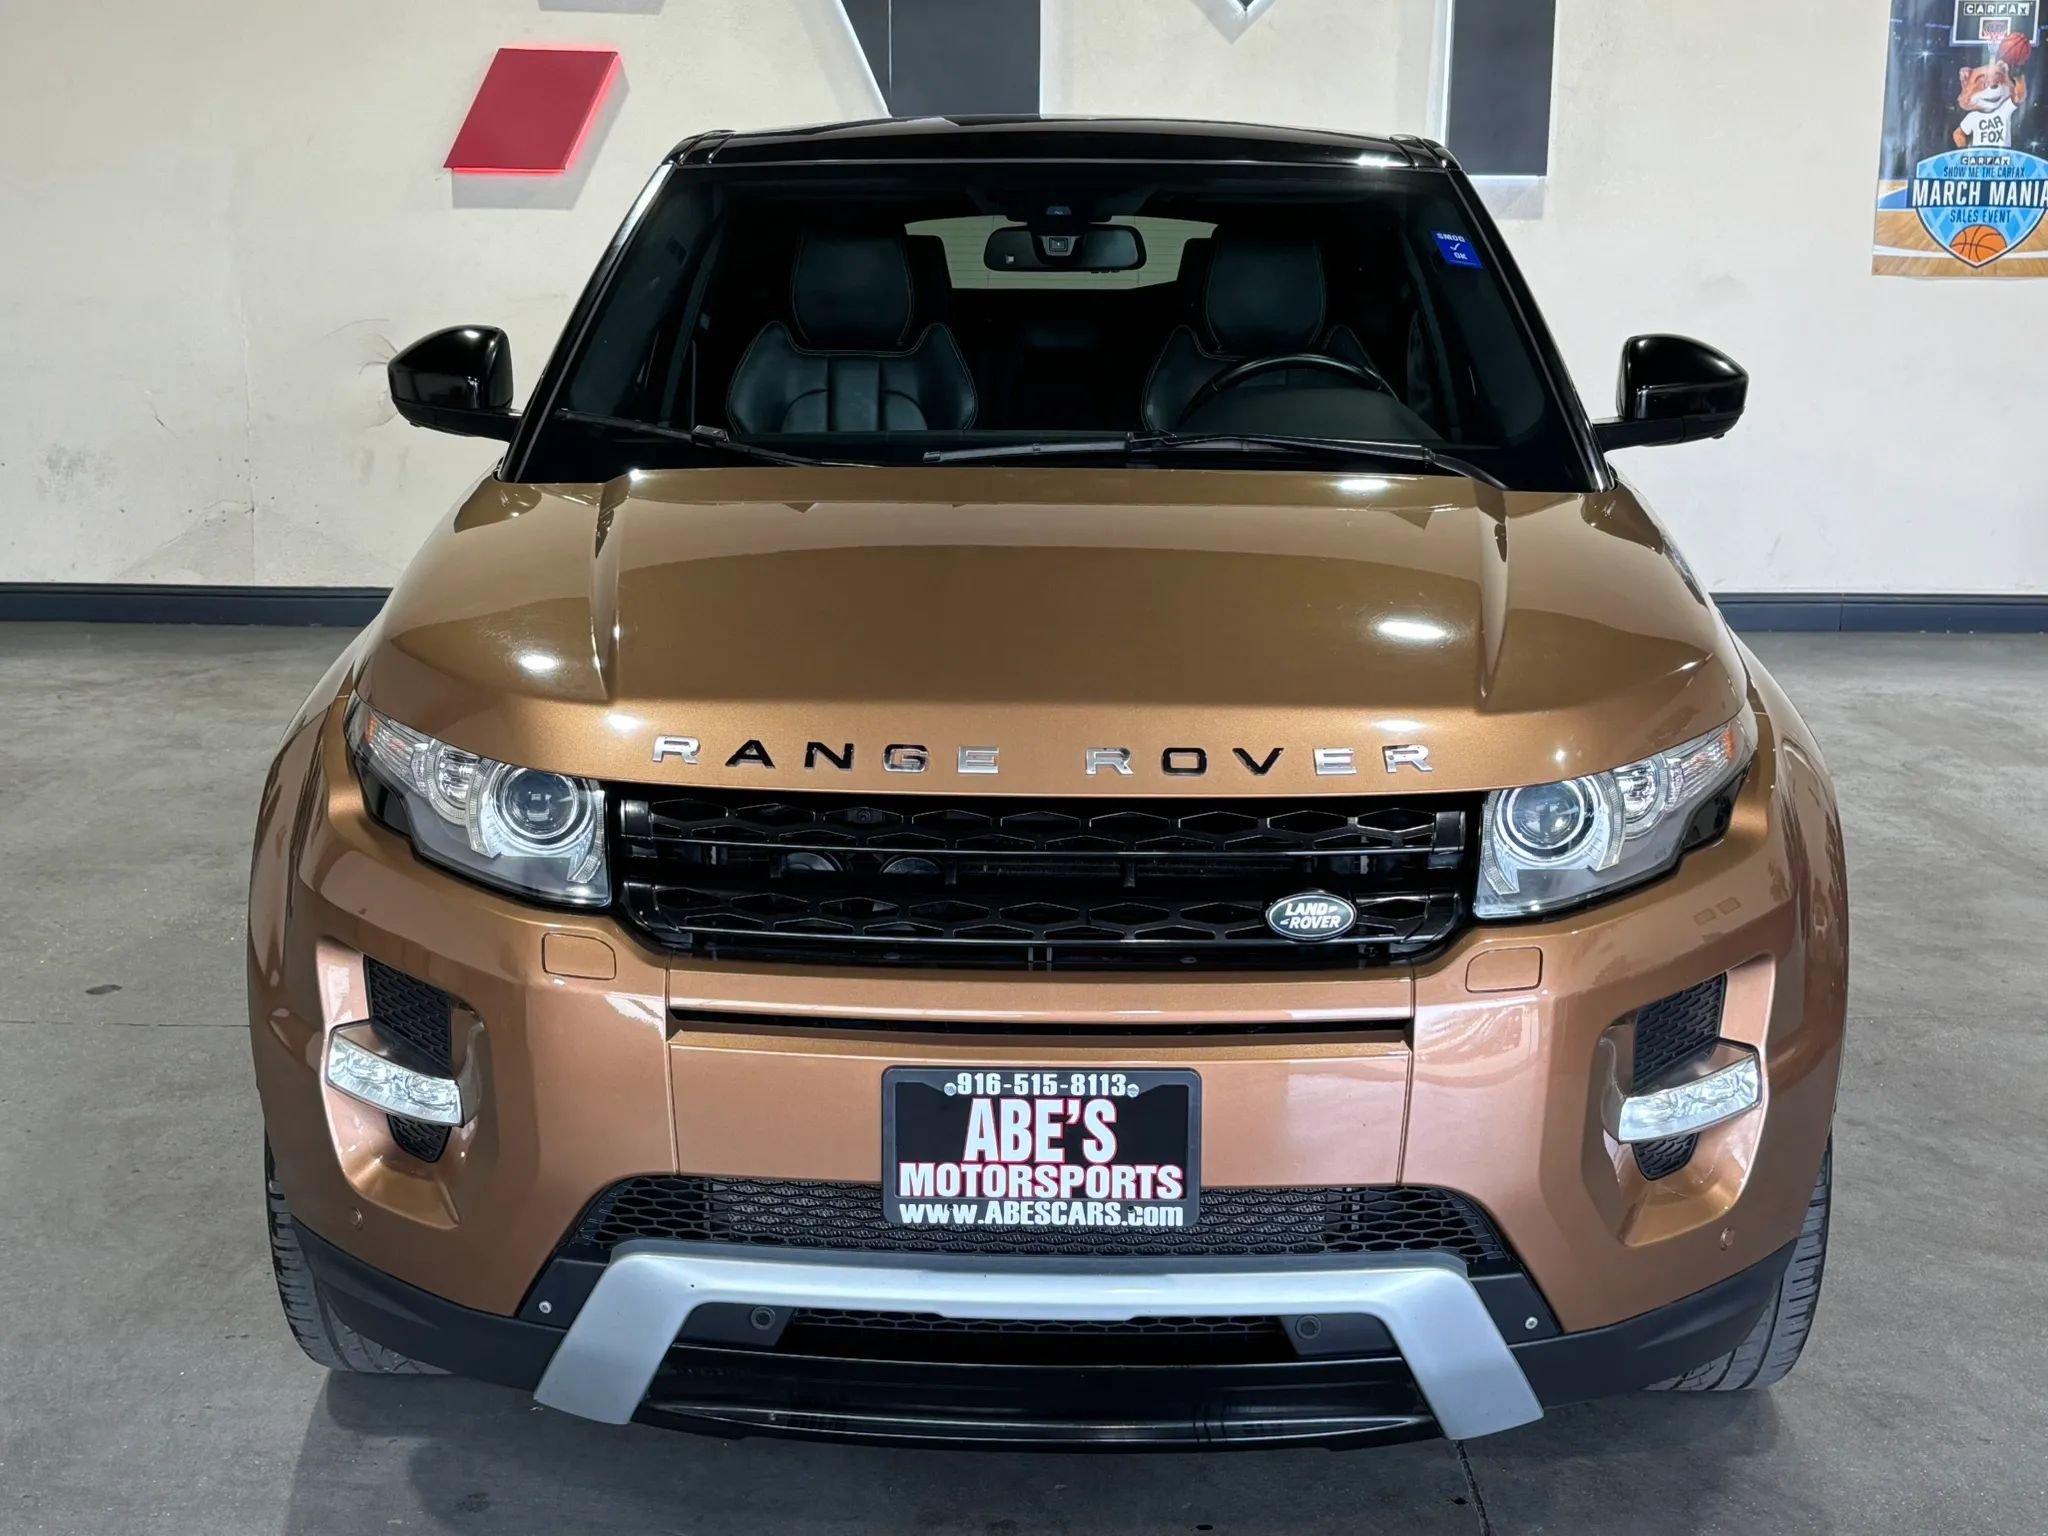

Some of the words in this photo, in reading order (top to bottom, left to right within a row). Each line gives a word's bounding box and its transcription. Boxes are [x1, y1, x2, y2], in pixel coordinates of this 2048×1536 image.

[1964, 2, 2029, 15] CARFAX
[1979, 115, 2004, 130] CAR
[1980, 128, 2004, 143] FOX
[1961, 156, 2010, 166] CARFAX
[1943, 166, 1966, 178] SHOW
[1968, 166, 1980, 178] ME
[1982, 166, 1995, 178] THE
[1997, 166, 2025, 178] CARFAX
[1912, 179, 1981, 207] MARCH
[1989, 180, 2048, 208] MANIA
[1950, 209, 1980, 223] SALES
[1982, 209, 2012, 223] EVENT
[651, 735, 1000, 775] RANGE
[1085, 743, 1434, 777] ROVER
[1285, 902, 1329, 916] LAND
[1288, 915, 1342, 930] ROVER
[956, 1072, 1127, 1096] 916-515-8113
[962, 1097, 1118, 1164] ABE'S
[899, 1162, 1184, 1200] MOTORSPORTS
